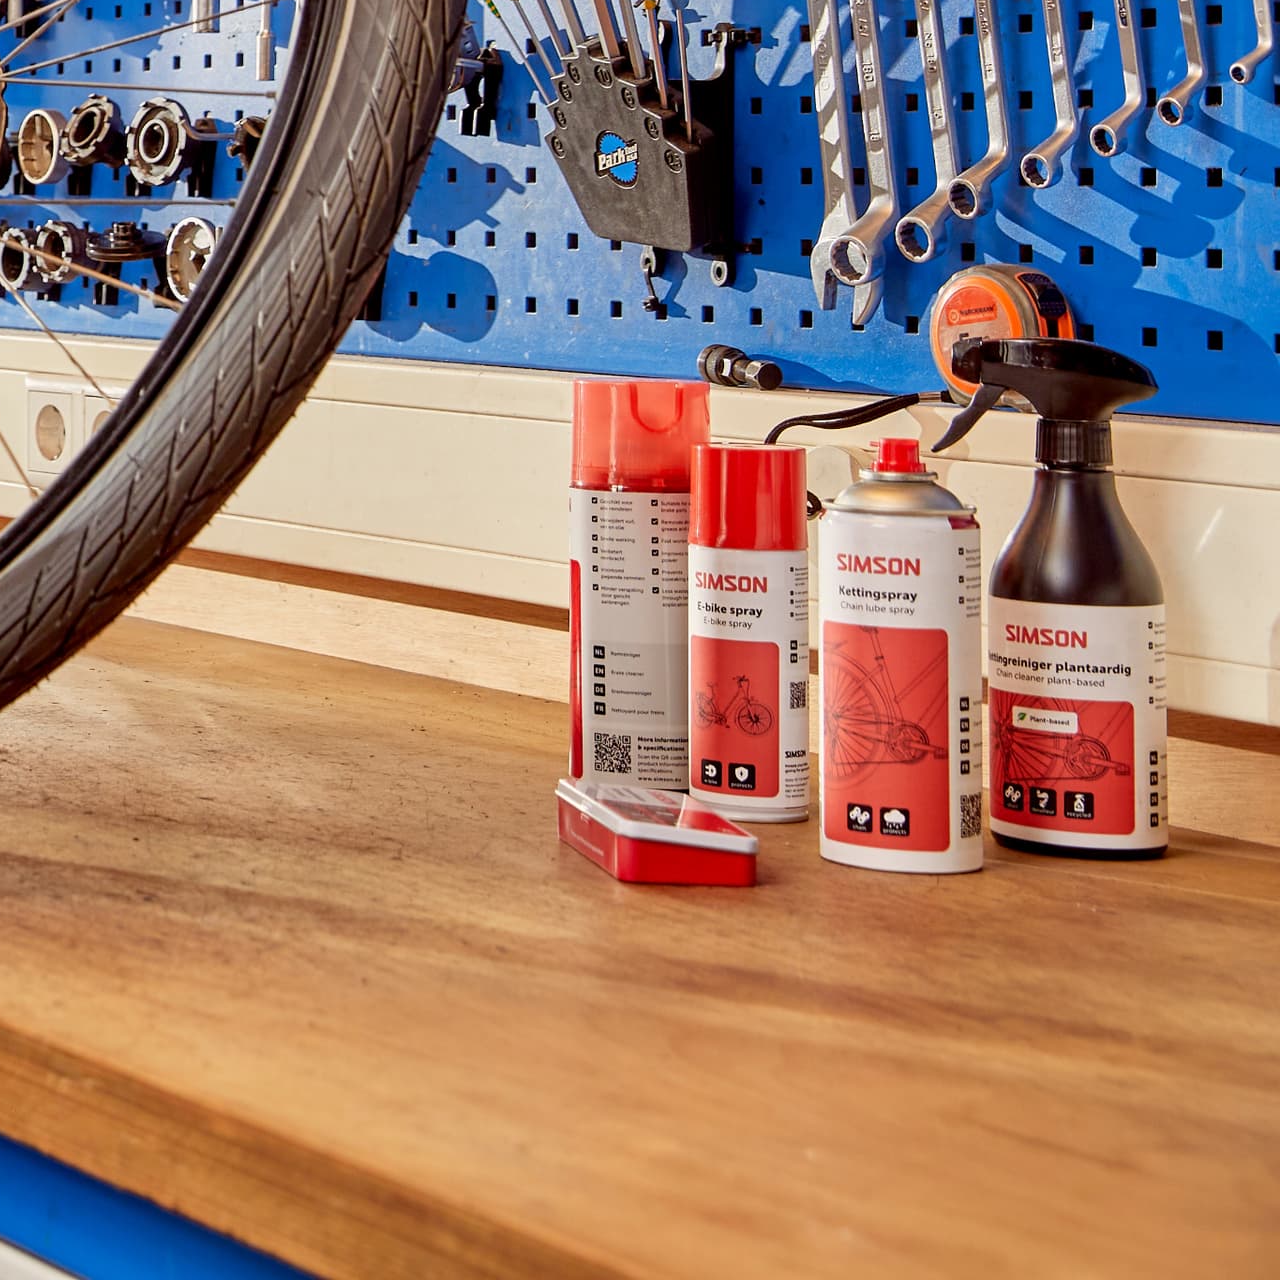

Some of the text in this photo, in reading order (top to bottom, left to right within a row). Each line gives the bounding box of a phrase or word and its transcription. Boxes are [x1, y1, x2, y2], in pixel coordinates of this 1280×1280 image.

[598, 147, 627, 171] Park
[836, 552, 921, 577] SIMSON
[695, 570, 768, 594] SIMSON
[838, 585, 918, 602] Kettingspray
[697, 601, 763, 618] E-bike spray
[840, 600, 916, 616] Chain lube spray
[703, 616, 753, 630] E-bike spray
[1005, 623, 1088, 649] SIMSON
[996, 667, 1105, 688] Chain cleaner plant-based
[1055, 661, 1132, 677] plantaardig
[1029, 714, 1070, 726] Plant-based
